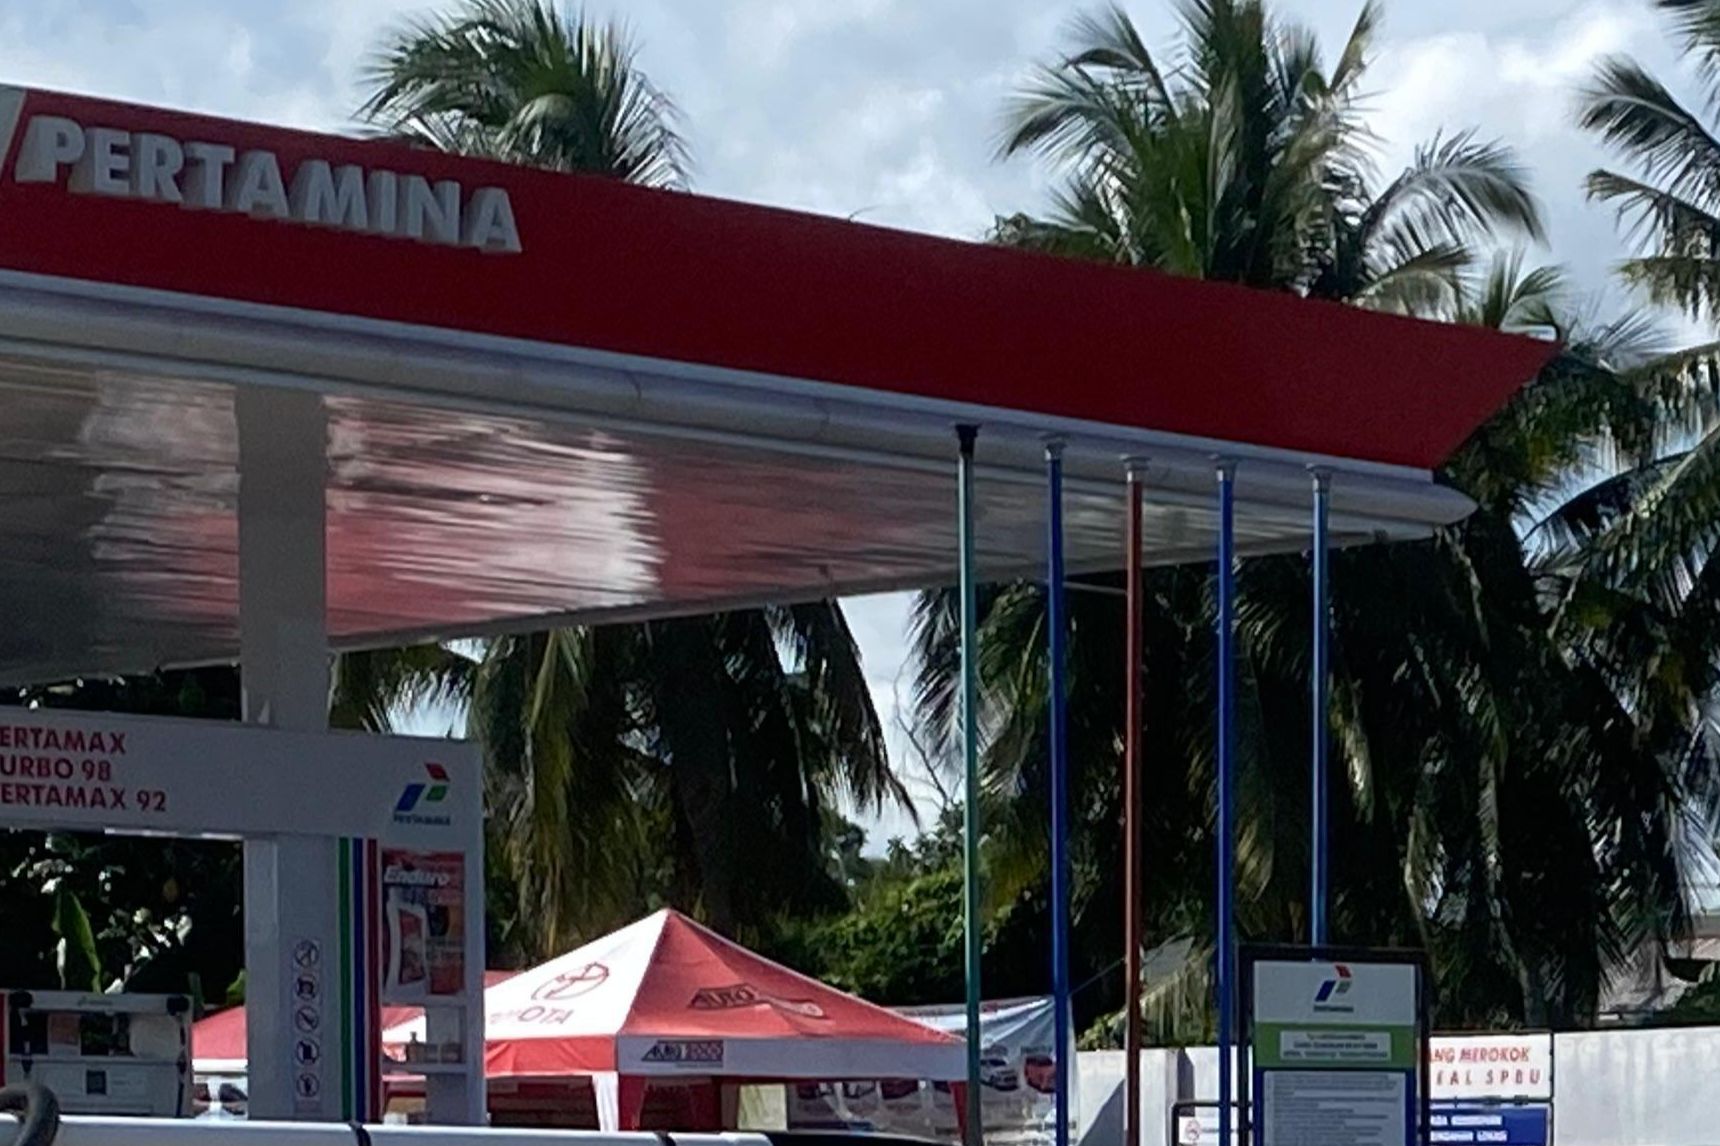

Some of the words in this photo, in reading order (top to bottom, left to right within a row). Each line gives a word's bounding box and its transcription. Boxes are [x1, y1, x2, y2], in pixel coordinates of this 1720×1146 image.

[14, 114, 523, 254] PERTAMINA
[0, 725, 126, 755] ERTAMAX
[0, 754, 74, 779] URBO
[81, 759, 112, 782] 98
[0, 783, 127, 810] ERTAMAX
[136, 790, 167, 812] 92
[384, 863, 450, 888] Enduro
